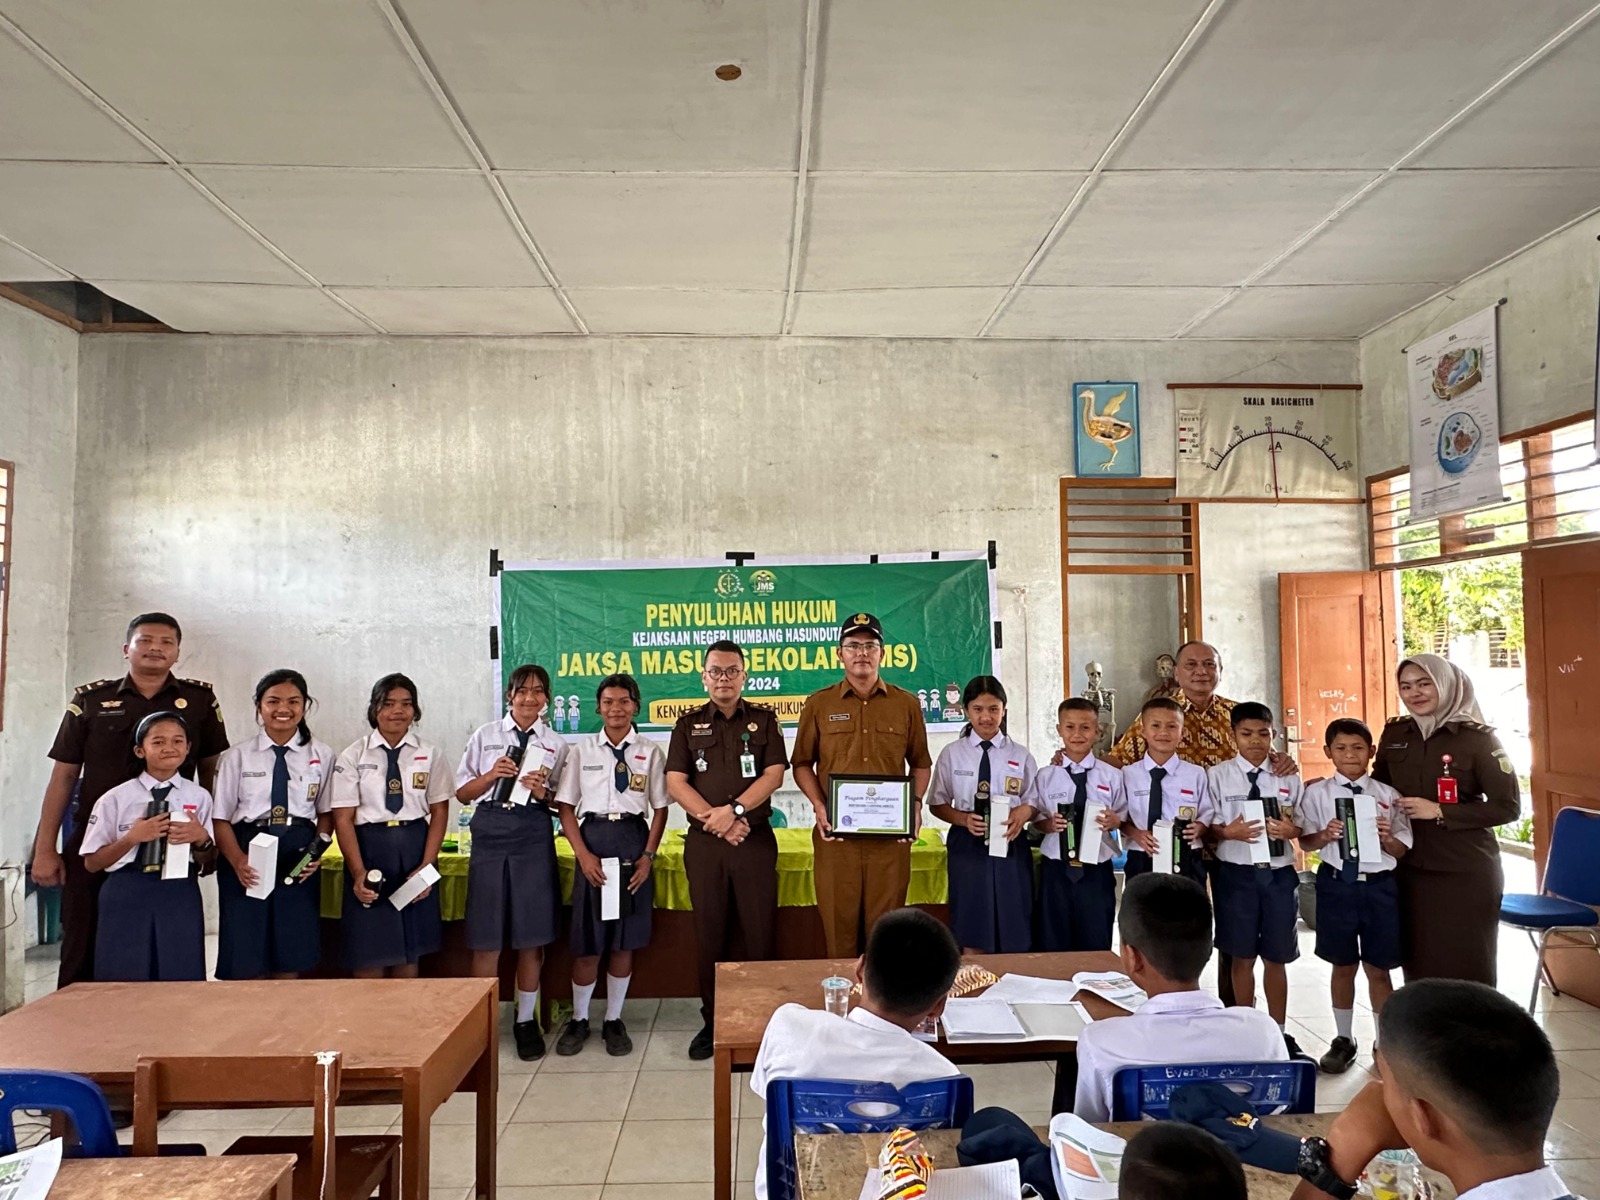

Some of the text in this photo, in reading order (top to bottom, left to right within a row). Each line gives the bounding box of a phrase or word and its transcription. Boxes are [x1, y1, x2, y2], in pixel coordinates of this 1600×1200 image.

[1243, 397, 1314, 406] SKALA BASICMETER
[756, 582, 775, 591] JMS
[646, 600, 836, 627] PENYULUHAN HUKUM
[633, 627, 842, 646] KEJAKSAAN NEGERI HUMBANG HASUNDUTA
[558, 652, 634, 677] JAKSA
[641, 649, 705, 675] MASU
[748, 677, 780, 690] 2024
